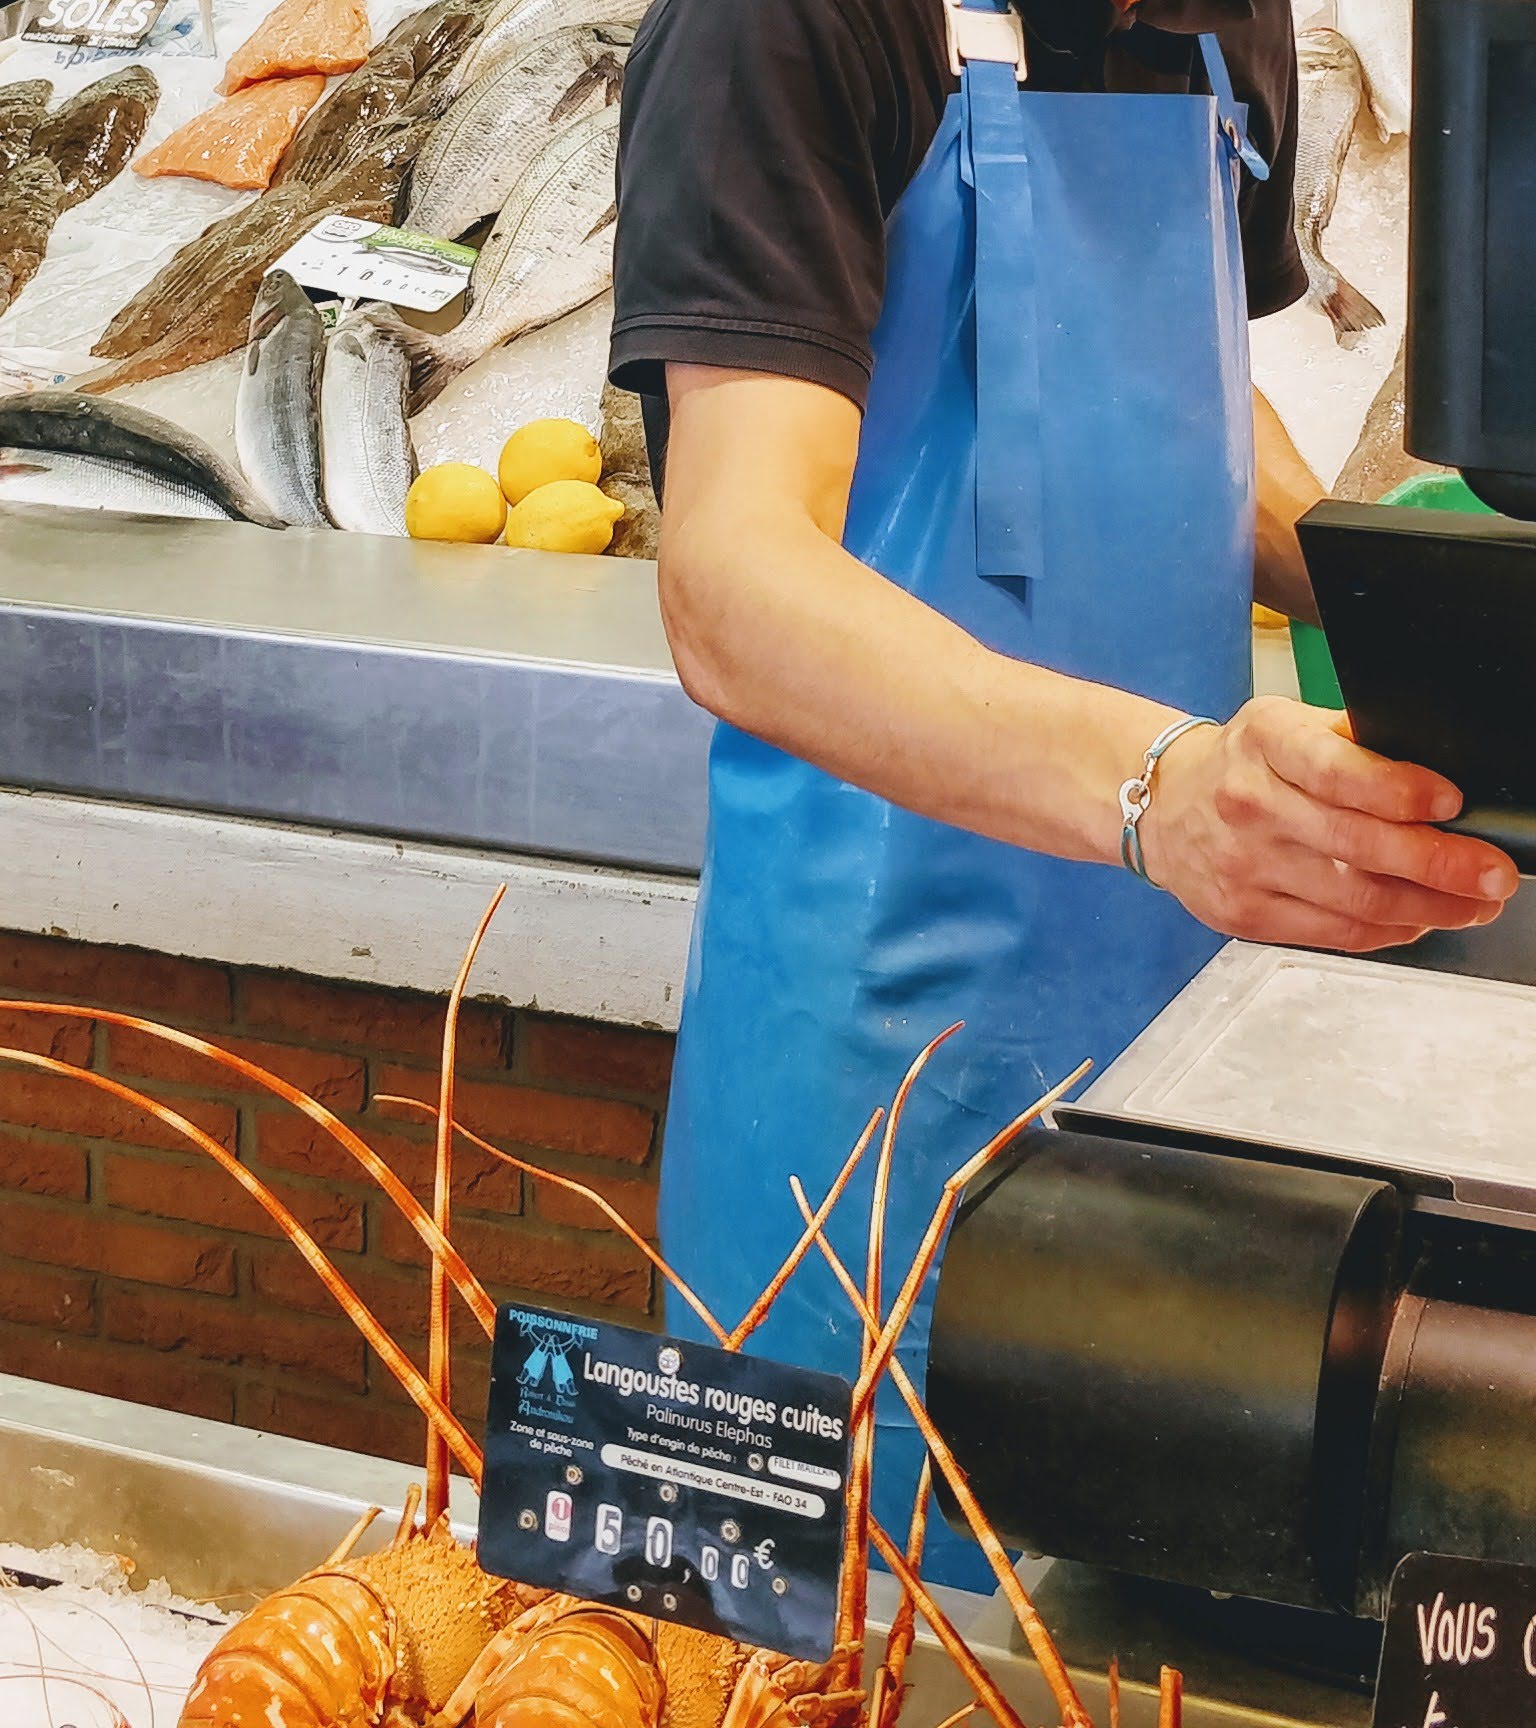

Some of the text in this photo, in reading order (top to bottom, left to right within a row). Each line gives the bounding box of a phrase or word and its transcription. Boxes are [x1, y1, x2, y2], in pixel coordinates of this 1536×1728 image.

[583, 1352, 844, 1441] Langoustes rouges cuites
[510, 1420, 594, 1450] Zone et sous-zone
[627, 1426, 733, 1463] Type d'engin de pêche
[646, 1404, 773, 1449] Palinurus Elephas
[529, 1438, 572, 1457] de pêche
[620, 1454, 808, 1510] Pêché en Atlantique Centre-Est FAO 34
[753, 1538, 776, 1570] €
[1418, 1592, 1497, 1666] VOUS
